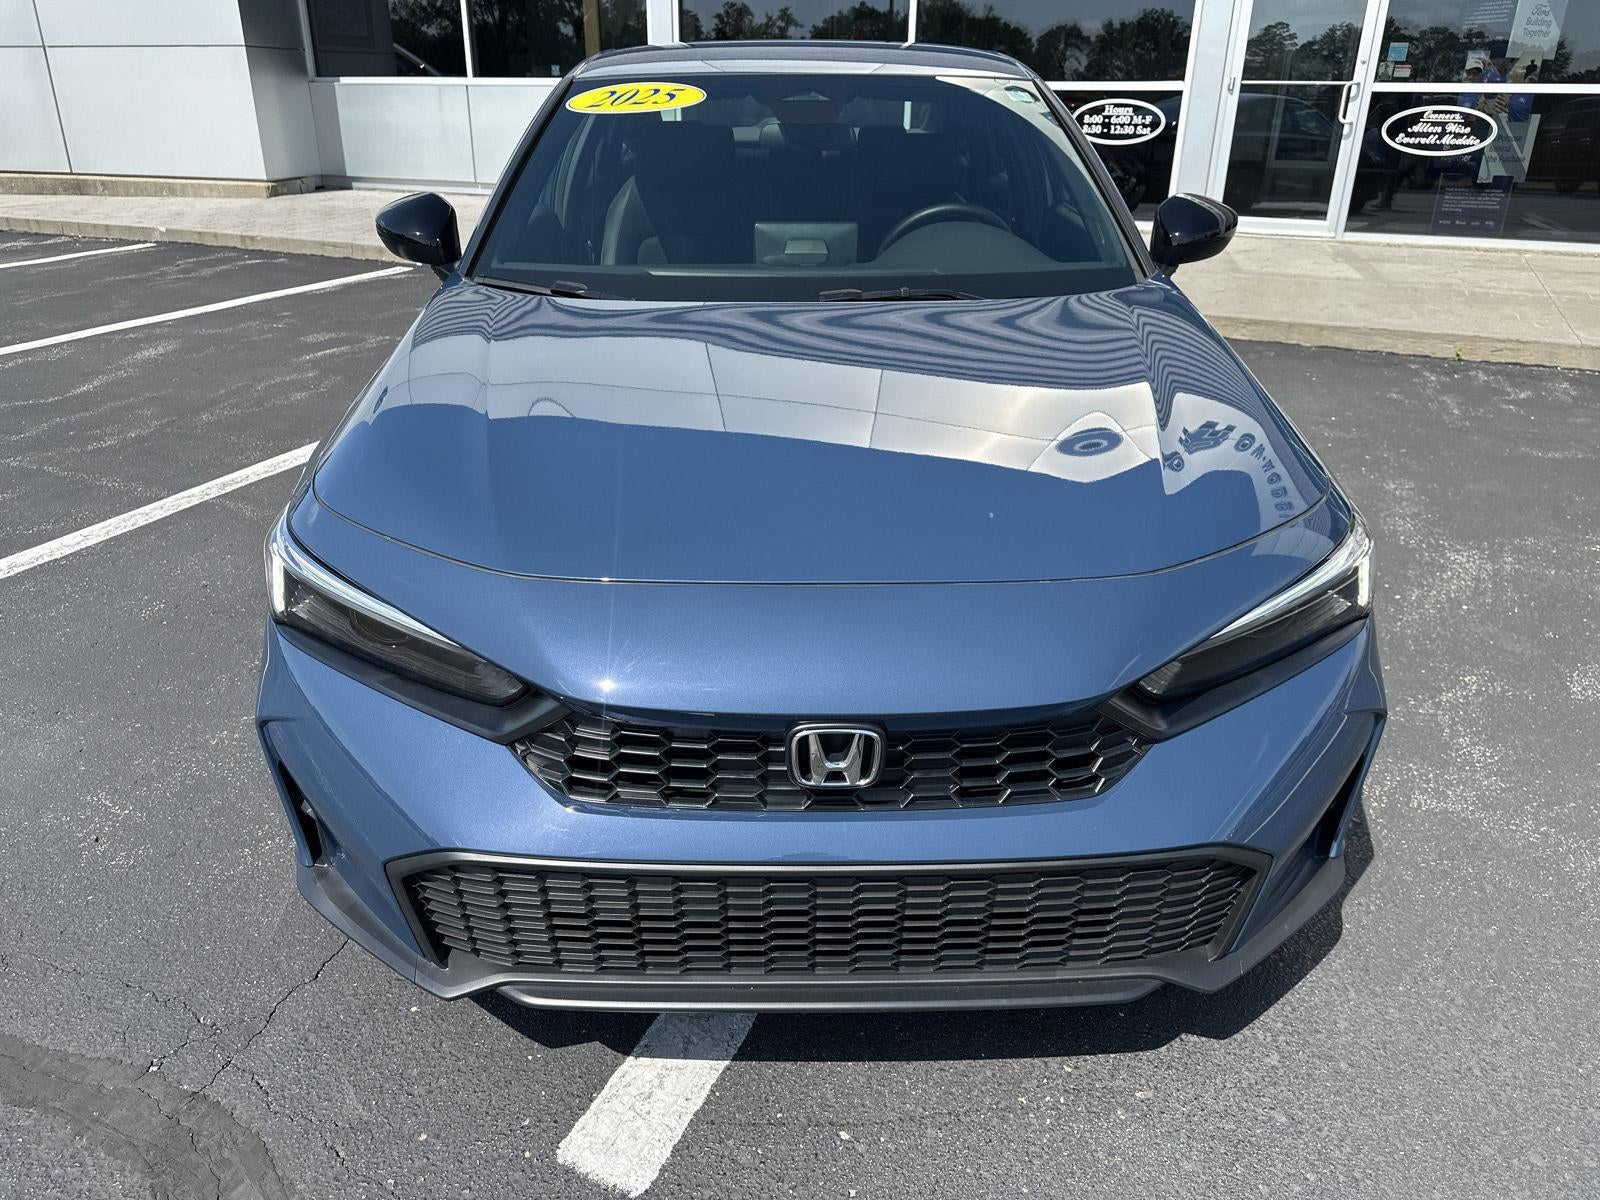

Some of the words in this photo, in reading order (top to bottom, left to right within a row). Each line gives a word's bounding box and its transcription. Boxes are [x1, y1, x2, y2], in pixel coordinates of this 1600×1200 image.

[1525, 17, 1552, 29] Building
[1523, 27, 1552, 39] Together
[585, 88, 687, 109] 2025
[1104, 104, 1134, 114] Hours
[1083, 114, 1103, 124] 8:00
[1110, 115, 1131, 124] 6:00
[1131, 115, 1153, 124] M-F
[1110, 125, 1135, 134] 12:30
[1136, 125, 1152, 135] Sat
[1407, 122, 1442, 133] Allen
